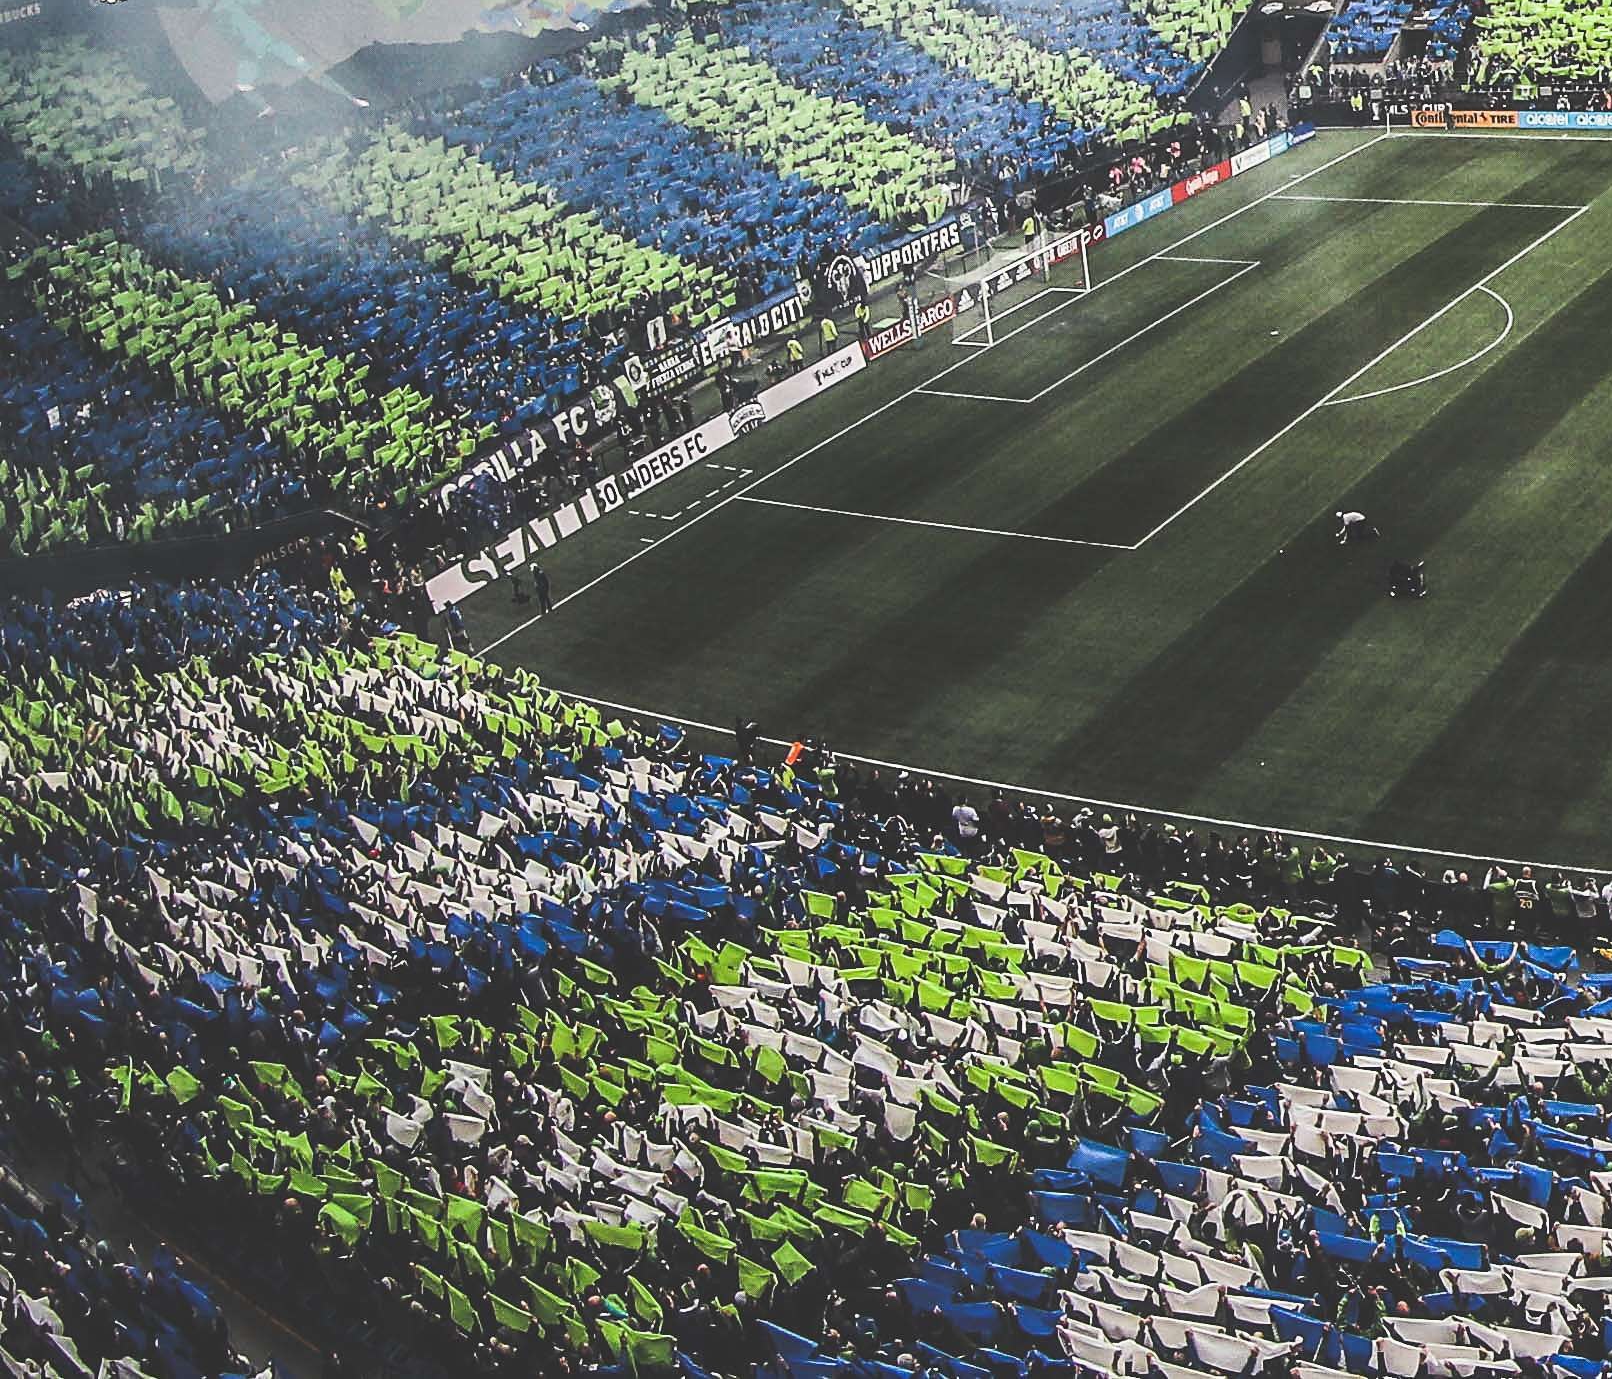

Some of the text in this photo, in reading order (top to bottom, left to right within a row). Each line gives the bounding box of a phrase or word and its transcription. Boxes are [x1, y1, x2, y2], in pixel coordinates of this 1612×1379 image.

[1490, 114, 1516, 124] TIRE
[865, 222, 961, 286] SUPPORTERS
[699, 295, 805, 368] ERALD CITY
[868, 320, 912, 355] WELLS
[552, 406, 588, 444] FC
[684, 433, 708, 461] FC
